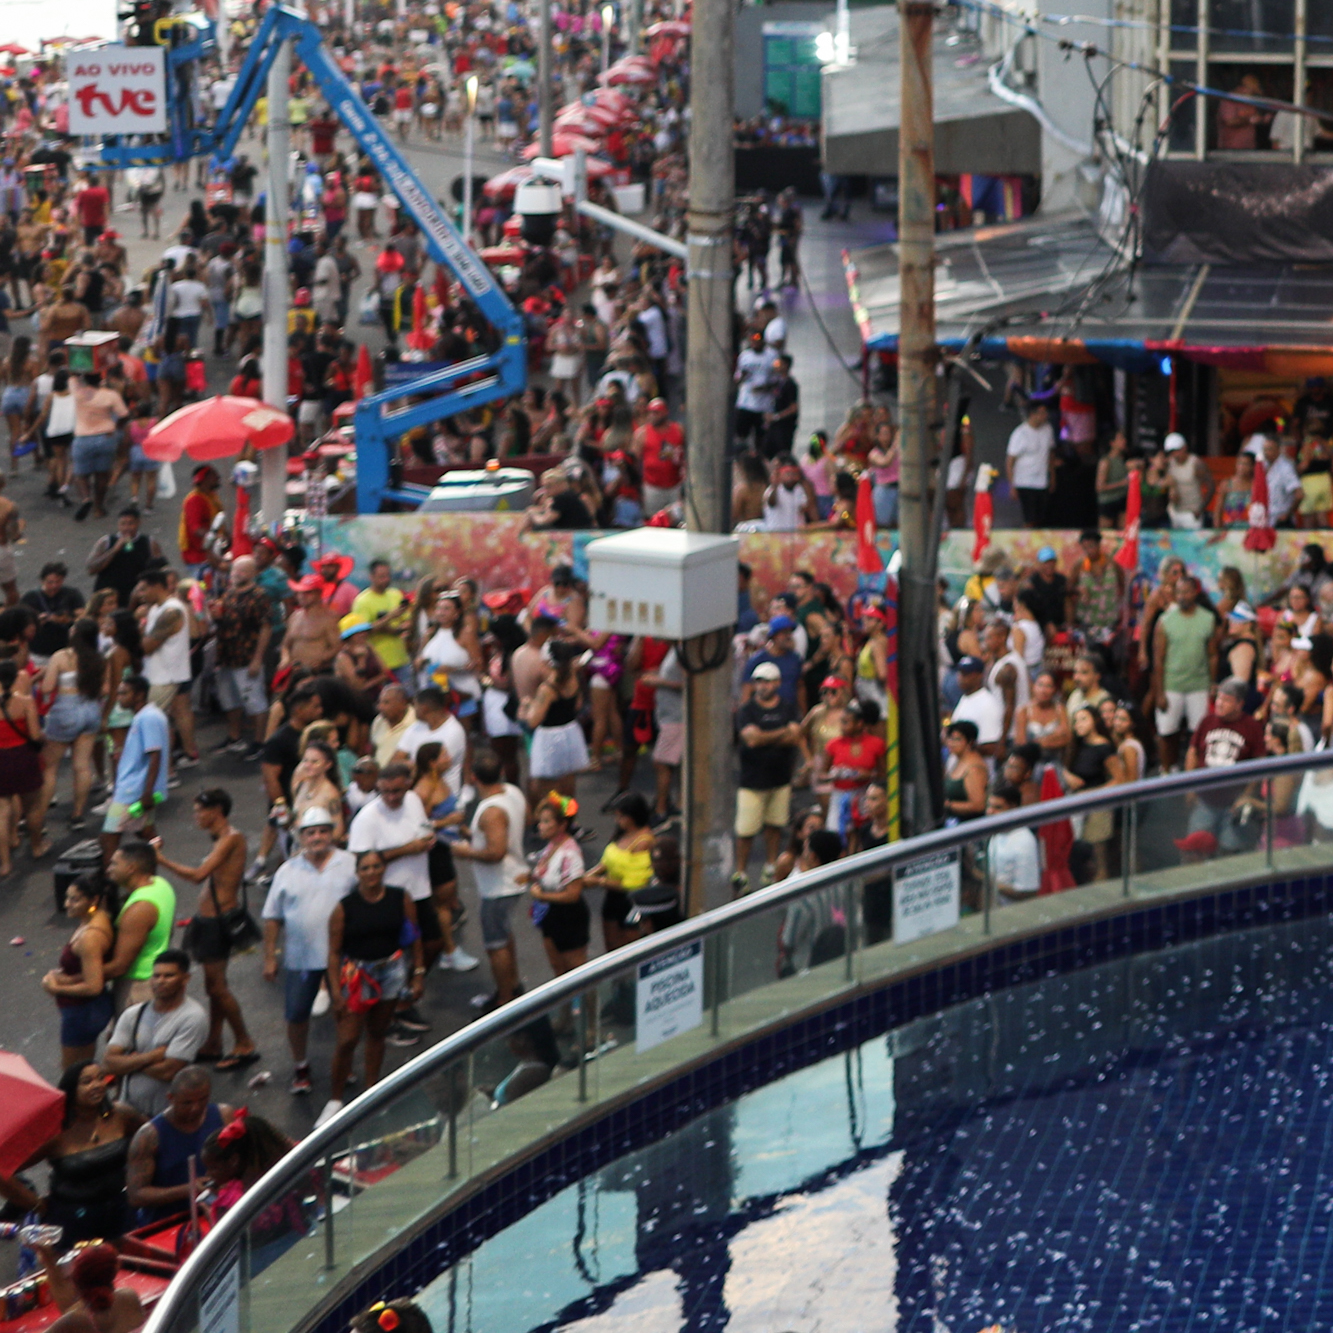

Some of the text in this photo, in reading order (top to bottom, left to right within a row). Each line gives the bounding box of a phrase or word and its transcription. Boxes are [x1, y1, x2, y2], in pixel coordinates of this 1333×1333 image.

[75, 63, 155, 76] AO VIVO
[75, 83, 156, 117] tve
